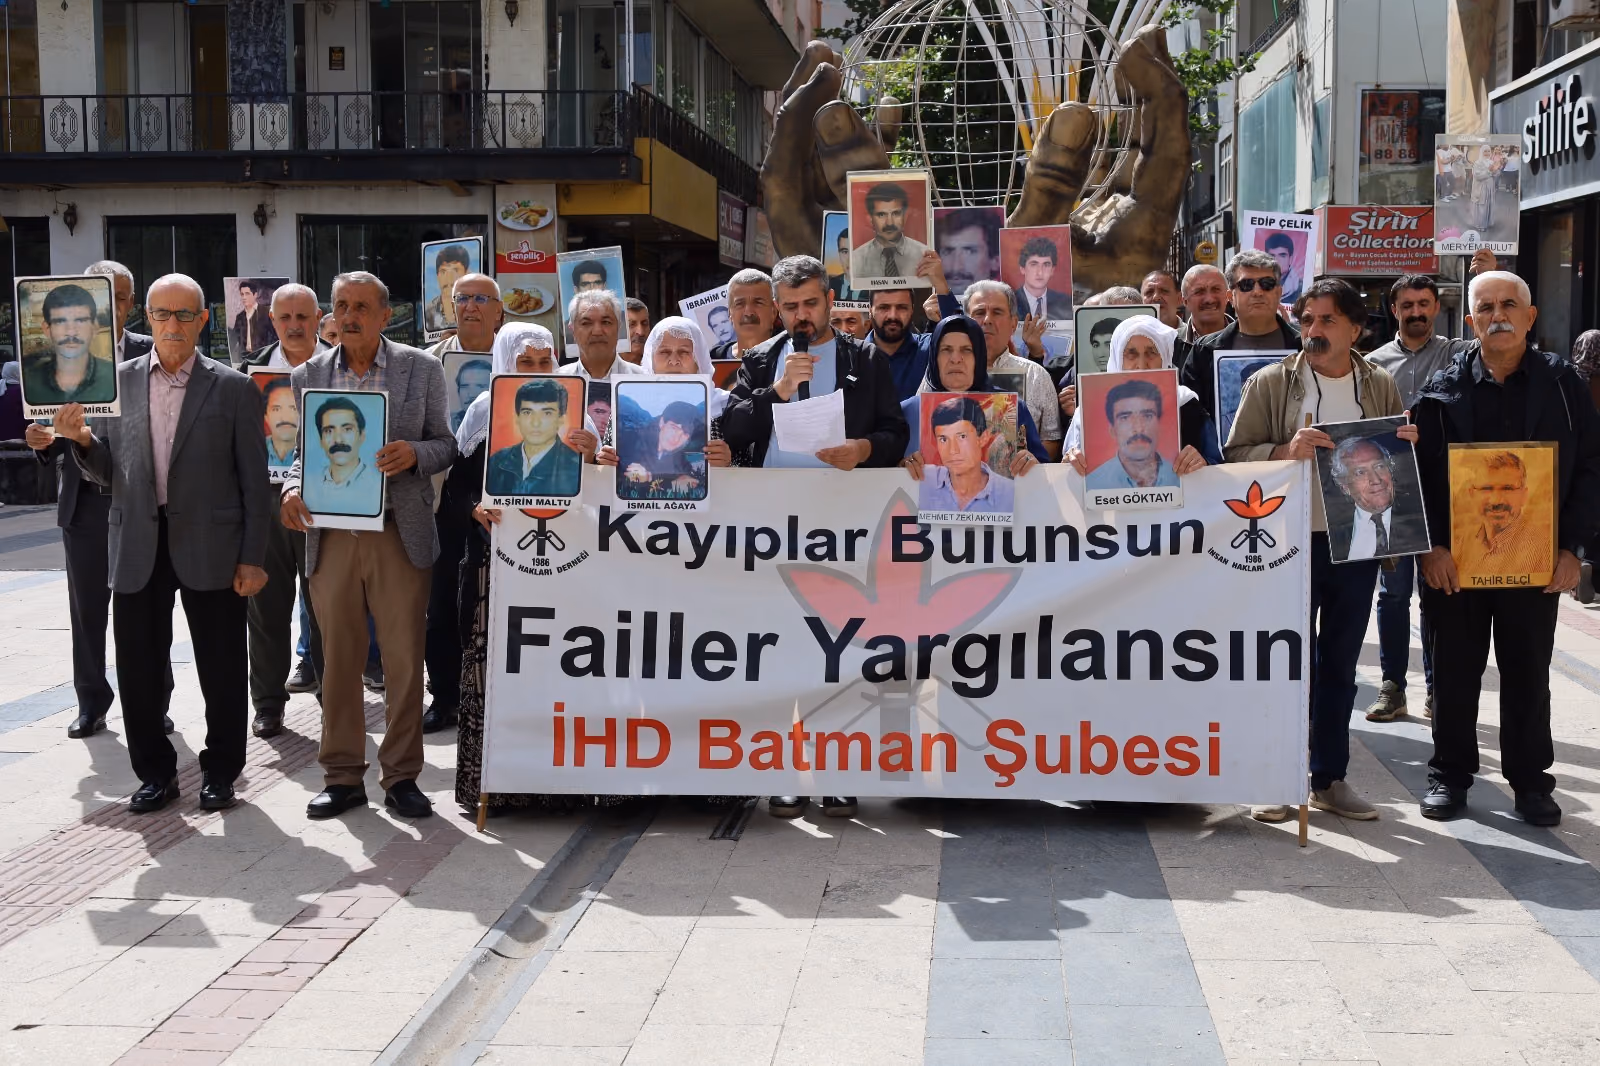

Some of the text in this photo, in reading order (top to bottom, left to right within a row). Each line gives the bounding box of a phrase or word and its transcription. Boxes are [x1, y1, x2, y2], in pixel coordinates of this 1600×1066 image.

[1522, 74, 1589, 163] stilife
[1250, 216, 1313, 230] EDİP ÇELİK
[1348, 210, 1419, 235] Şirin
[1333, 233, 1433, 249] Collection
[1441, 243, 1514, 251] MERYEM BULUT
[685, 293, 720, 310] İBRAHİM
[30, 405, 114, 416] MAHM MİREL
[493, 497, 572, 507] M.ŞİRİN MALTU
[627, 500, 697, 510] İSMAİL AĞAYA
[1094, 491, 1173, 505] Eset GÖKTAYI
[919, 513, 1012, 522] MEHMET ZEKİ AKYILDIZ
[598, 505, 1205, 571] Kayıplar Bulunsun
[517, 564, 553, 576] HAKLARI
[556, 549, 590, 574] DERNEĞİ
[531, 557, 550, 567] 1986
[1207, 545, 1300, 572] İNSAN HAKLARI DERNEĞİ
[1244, 554, 1262, 563] 1986
[1470, 573, 1530, 586] TAHİR ELÇİ
[505, 605, 1303, 698] Failler Yargılansın
[552, 701, 1221, 788] İHD Batman Şubesi
